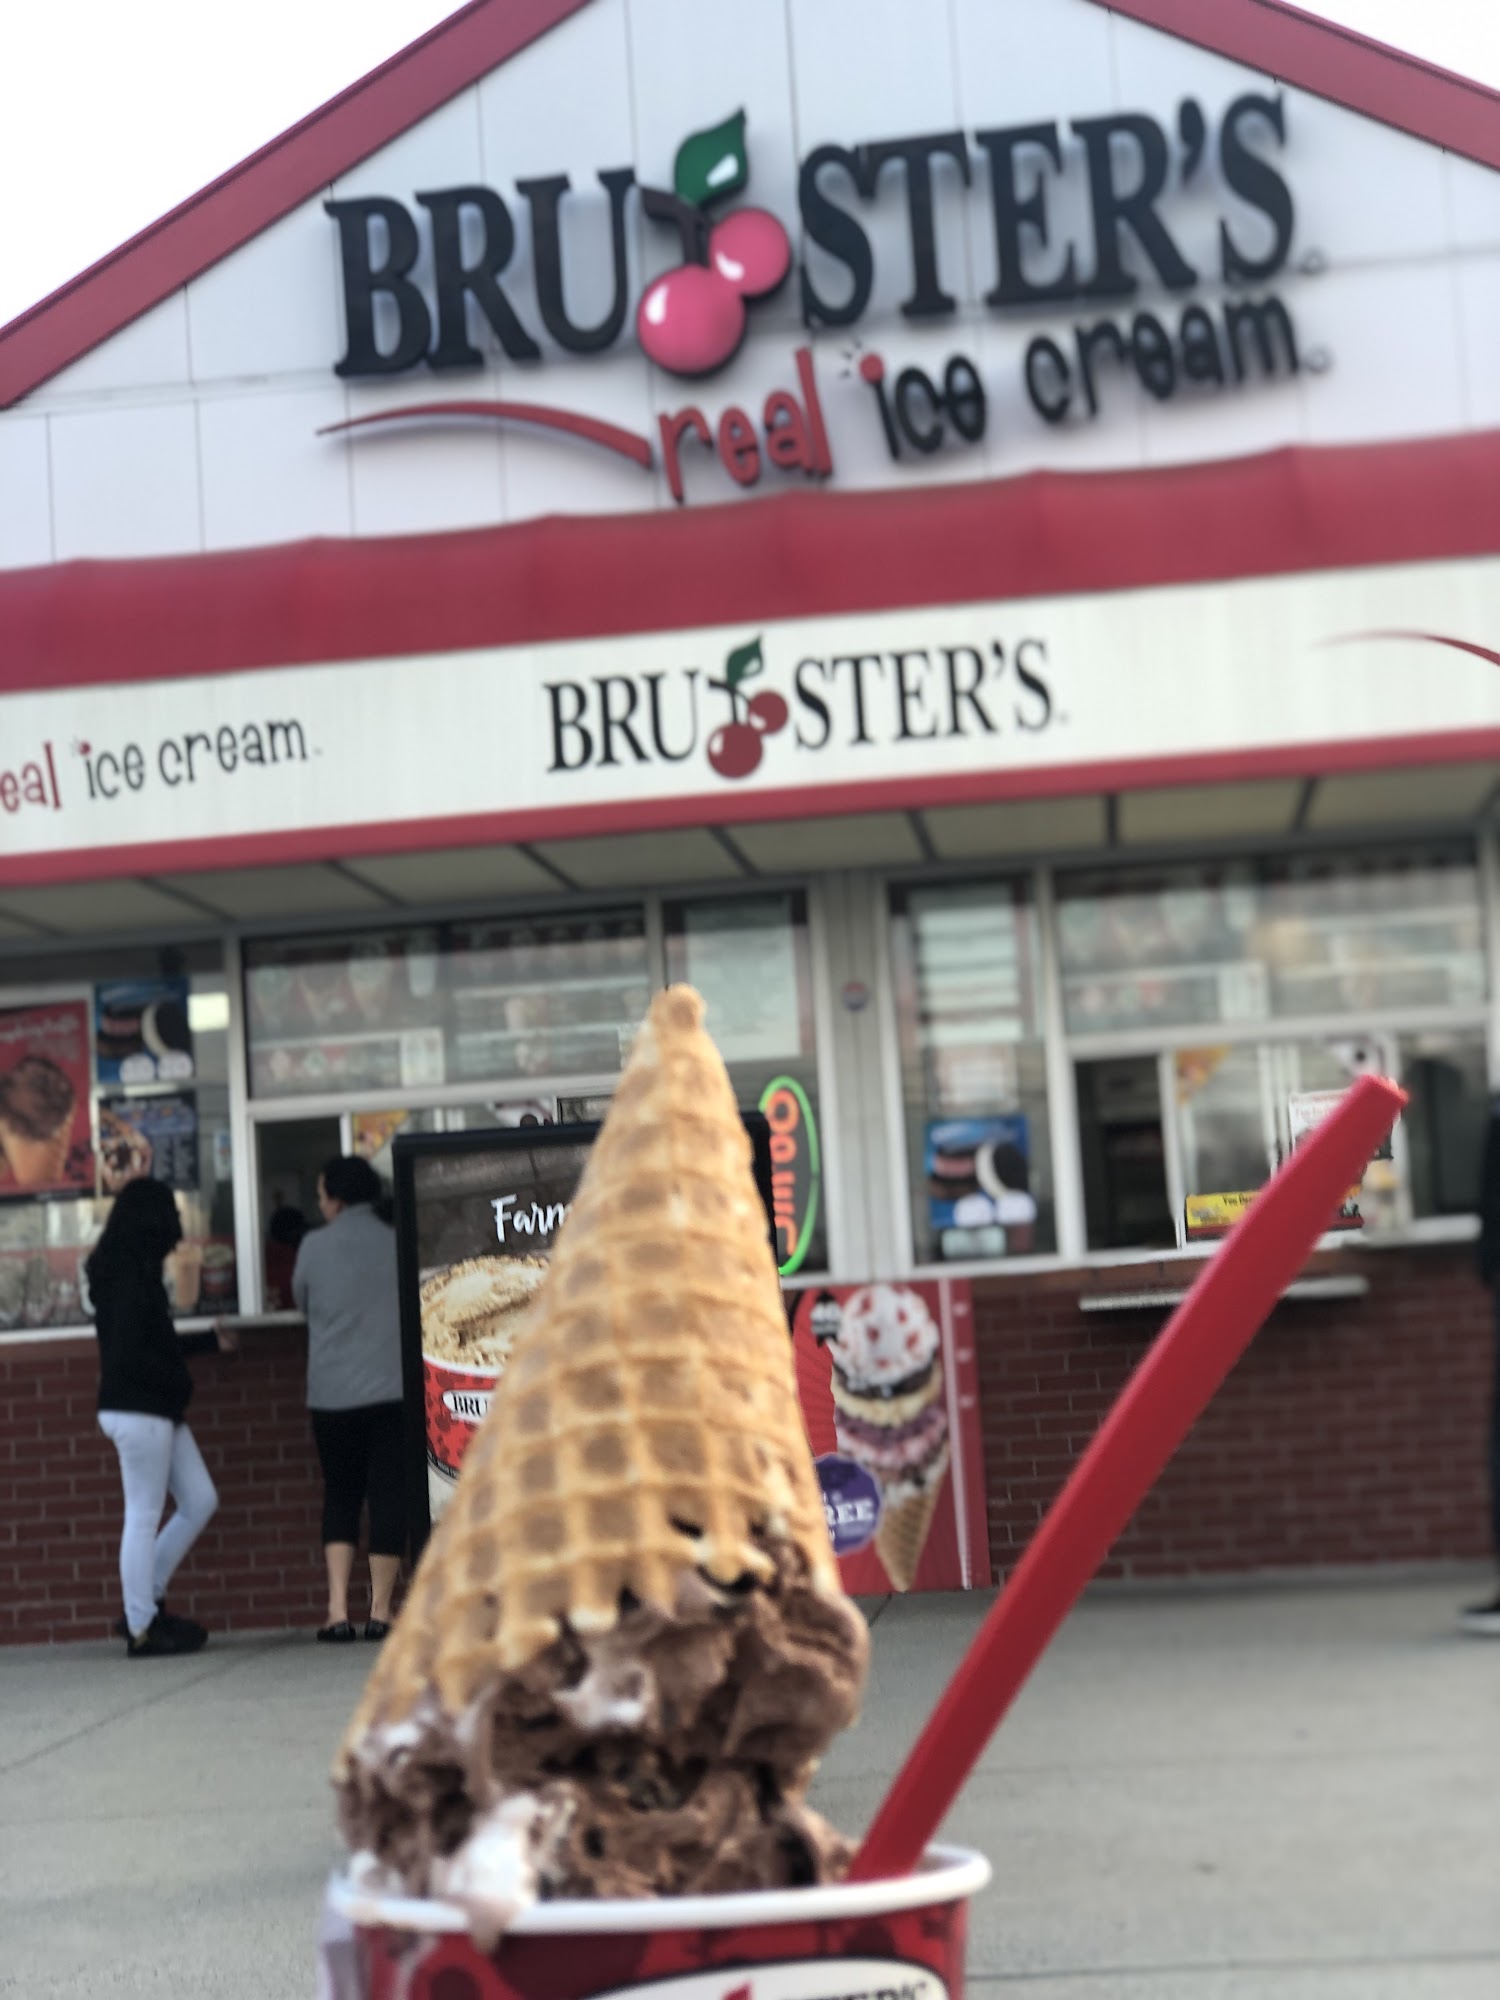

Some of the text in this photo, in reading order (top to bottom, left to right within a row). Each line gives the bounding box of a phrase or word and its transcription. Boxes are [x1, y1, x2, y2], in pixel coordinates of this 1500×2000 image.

[659, 296, 1300, 505] real ice cream
[0, 717, 308, 814] eal ice cream
[826, 1498, 875, 1525] REE
